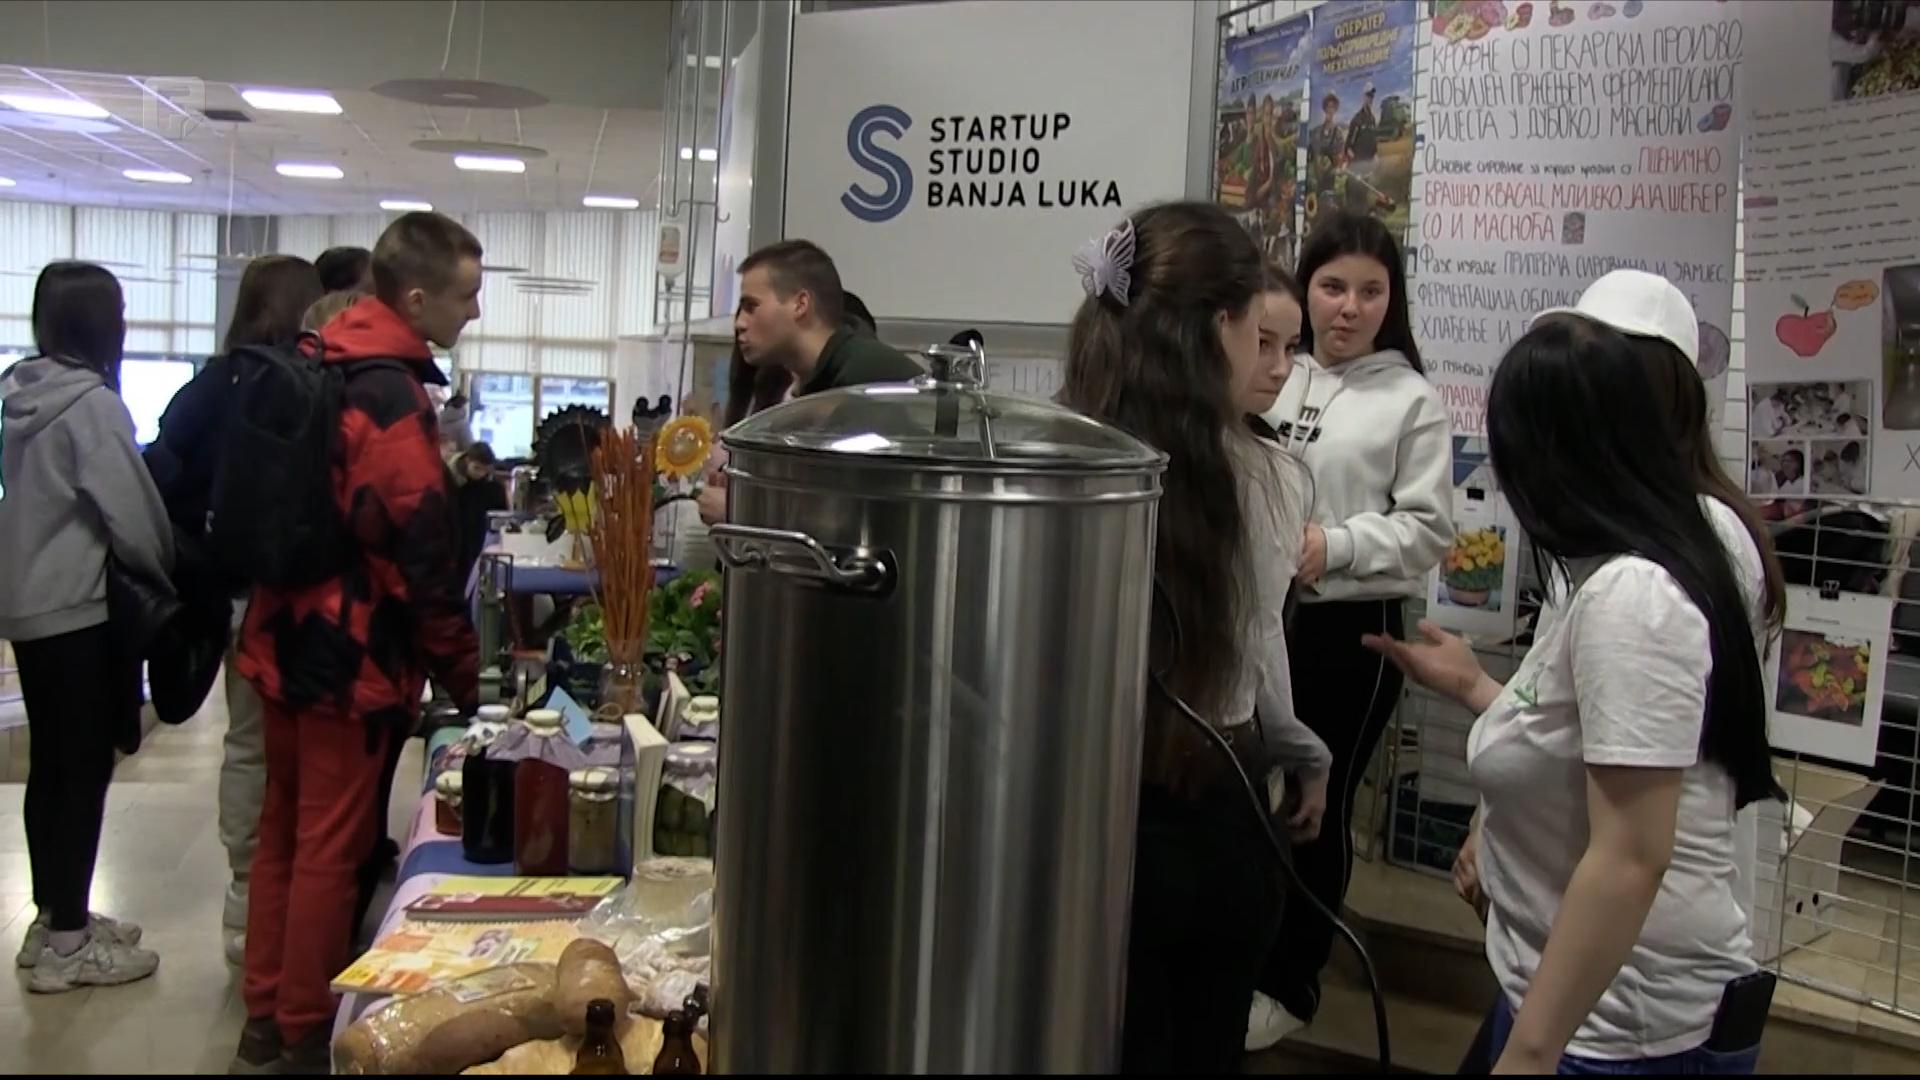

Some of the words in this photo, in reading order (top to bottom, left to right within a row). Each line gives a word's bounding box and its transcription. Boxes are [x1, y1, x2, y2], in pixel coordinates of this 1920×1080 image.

[1334, 11, 1385, 39] ОПЕРАТЕР
[1432, 38, 1500, 74] КРОФНЕ
[1511, 36, 1530, 71] СУ
[1540, 31, 1645, 70] ПЕКАРСКИ
[1427, 73, 1506, 107] ДОБИЈЕН
[1510, 71, 1597, 107] ПРЖЕЊЕМ
[1602, 61, 1743, 106] ФЕРМЕНТИСАНОГ
[930, 112, 1071, 143] STARTUP
[1428, 108, 1499, 141] ТИЈЕСТА
[1508, 108, 1519, 139] У
[1527, 105, 1601, 140] ДУБОКОЈ
[1609, 104, 1692, 138] МАСНОЋИ
[928, 147, 1040, 175] STUDIO
[1425, 143, 1473, 174] Основне
[1638, 145, 1722, 175] ПШЕНИЧНО
[927, 180, 1026, 208] BANJA
[1038, 179, 1122, 208] LUKA
[1422, 211, 1442, 240] СО
[1451, 212, 1463, 240] И
[1473, 211, 1554, 242] МАСНОЋА
[1503, 250, 1571, 277] ПРИПРЕМА
[1520, 288, 1583, 313] ОБЛИКО
[1419, 314, 1488, 344] ХЛАЂЕЊЕ
[1498, 318, 1512, 344] И
